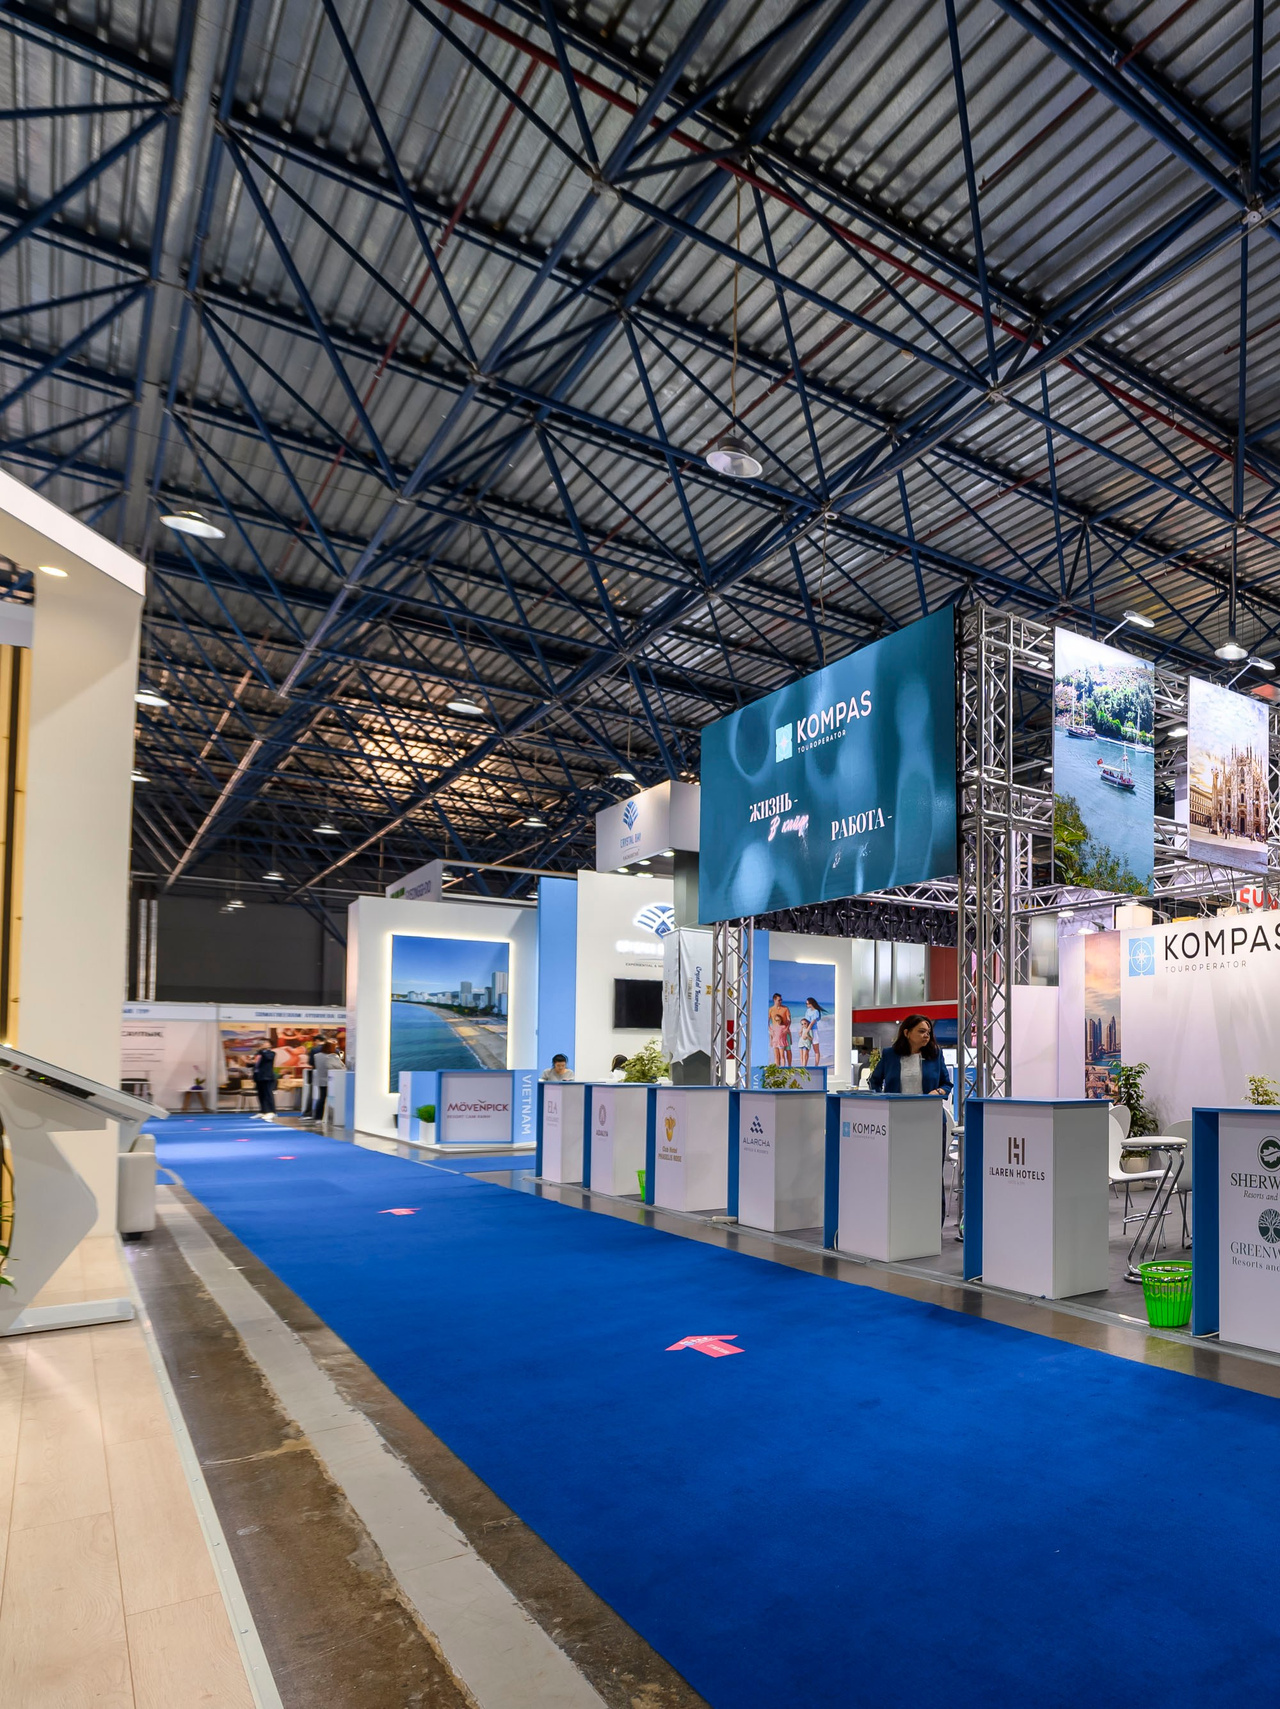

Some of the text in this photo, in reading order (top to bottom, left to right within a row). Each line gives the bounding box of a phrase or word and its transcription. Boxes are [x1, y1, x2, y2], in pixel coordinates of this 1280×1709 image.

[797, 690, 872, 744] KOMPAS
[797, 729, 847, 753] TOUROPERATOR
[749, 792, 793, 823] ЖИЗНЬ
[831, 807, 885, 841] РАБОТА
[1165, 960, 1247, 974] TOUROPERATOR
[521, 1074, 532, 1135] VIETNAM
[852, 1122, 887, 1137] KOMPAS
[742, 1137, 771, 1148] ALARCHA
[991, 1166, 1014, 1178] LAREN
[1016, 1169, 1045, 1181] HOTELS
[1243, 1189, 1265, 1200] Resorts
[1266, 1193, 1279, 1202] and
[1232, 1256, 1263, 1269] Resorts
